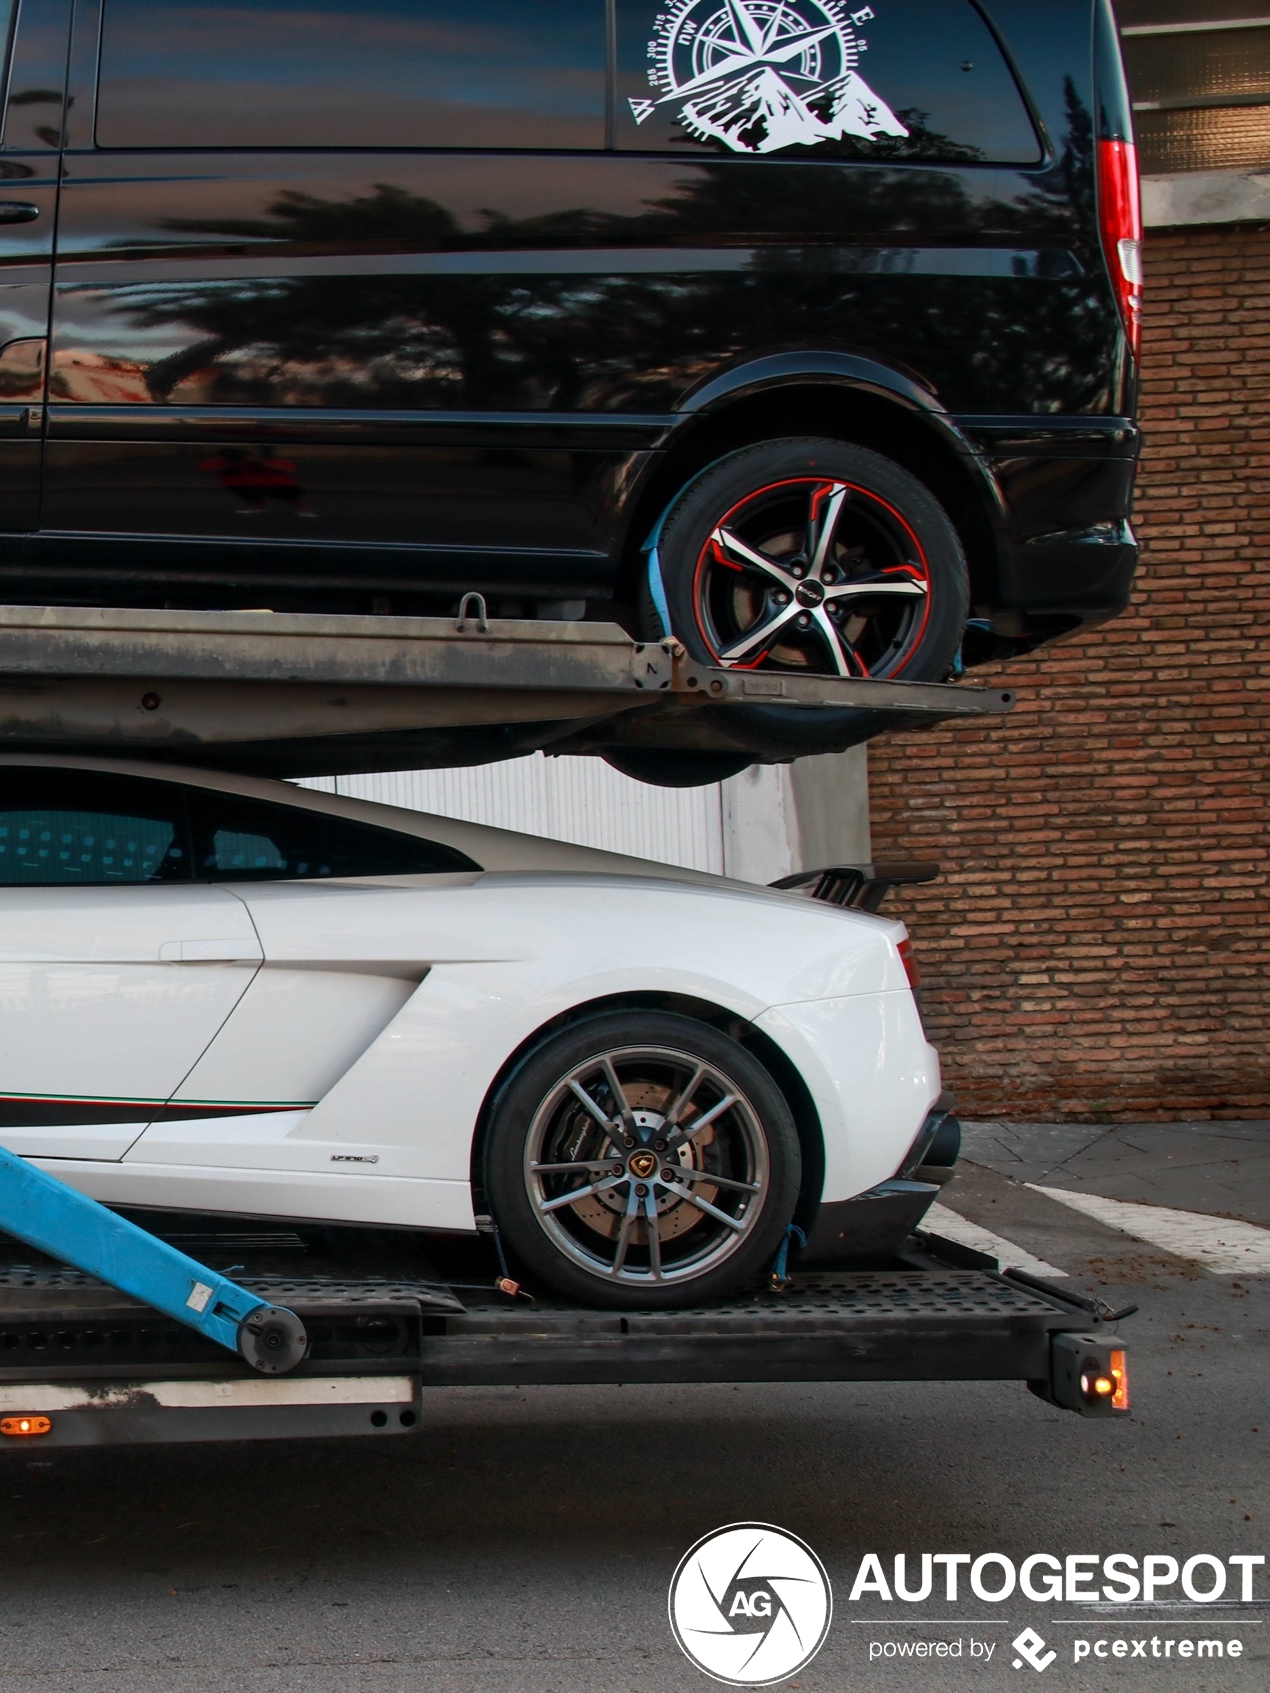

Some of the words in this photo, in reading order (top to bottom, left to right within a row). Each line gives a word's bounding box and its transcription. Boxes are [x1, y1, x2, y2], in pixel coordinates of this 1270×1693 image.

[652, 13, 666, 31] 315
[849, 6, 874, 26] E
[646, 40, 658, 59] 300
[646, 68, 659, 87] 285
